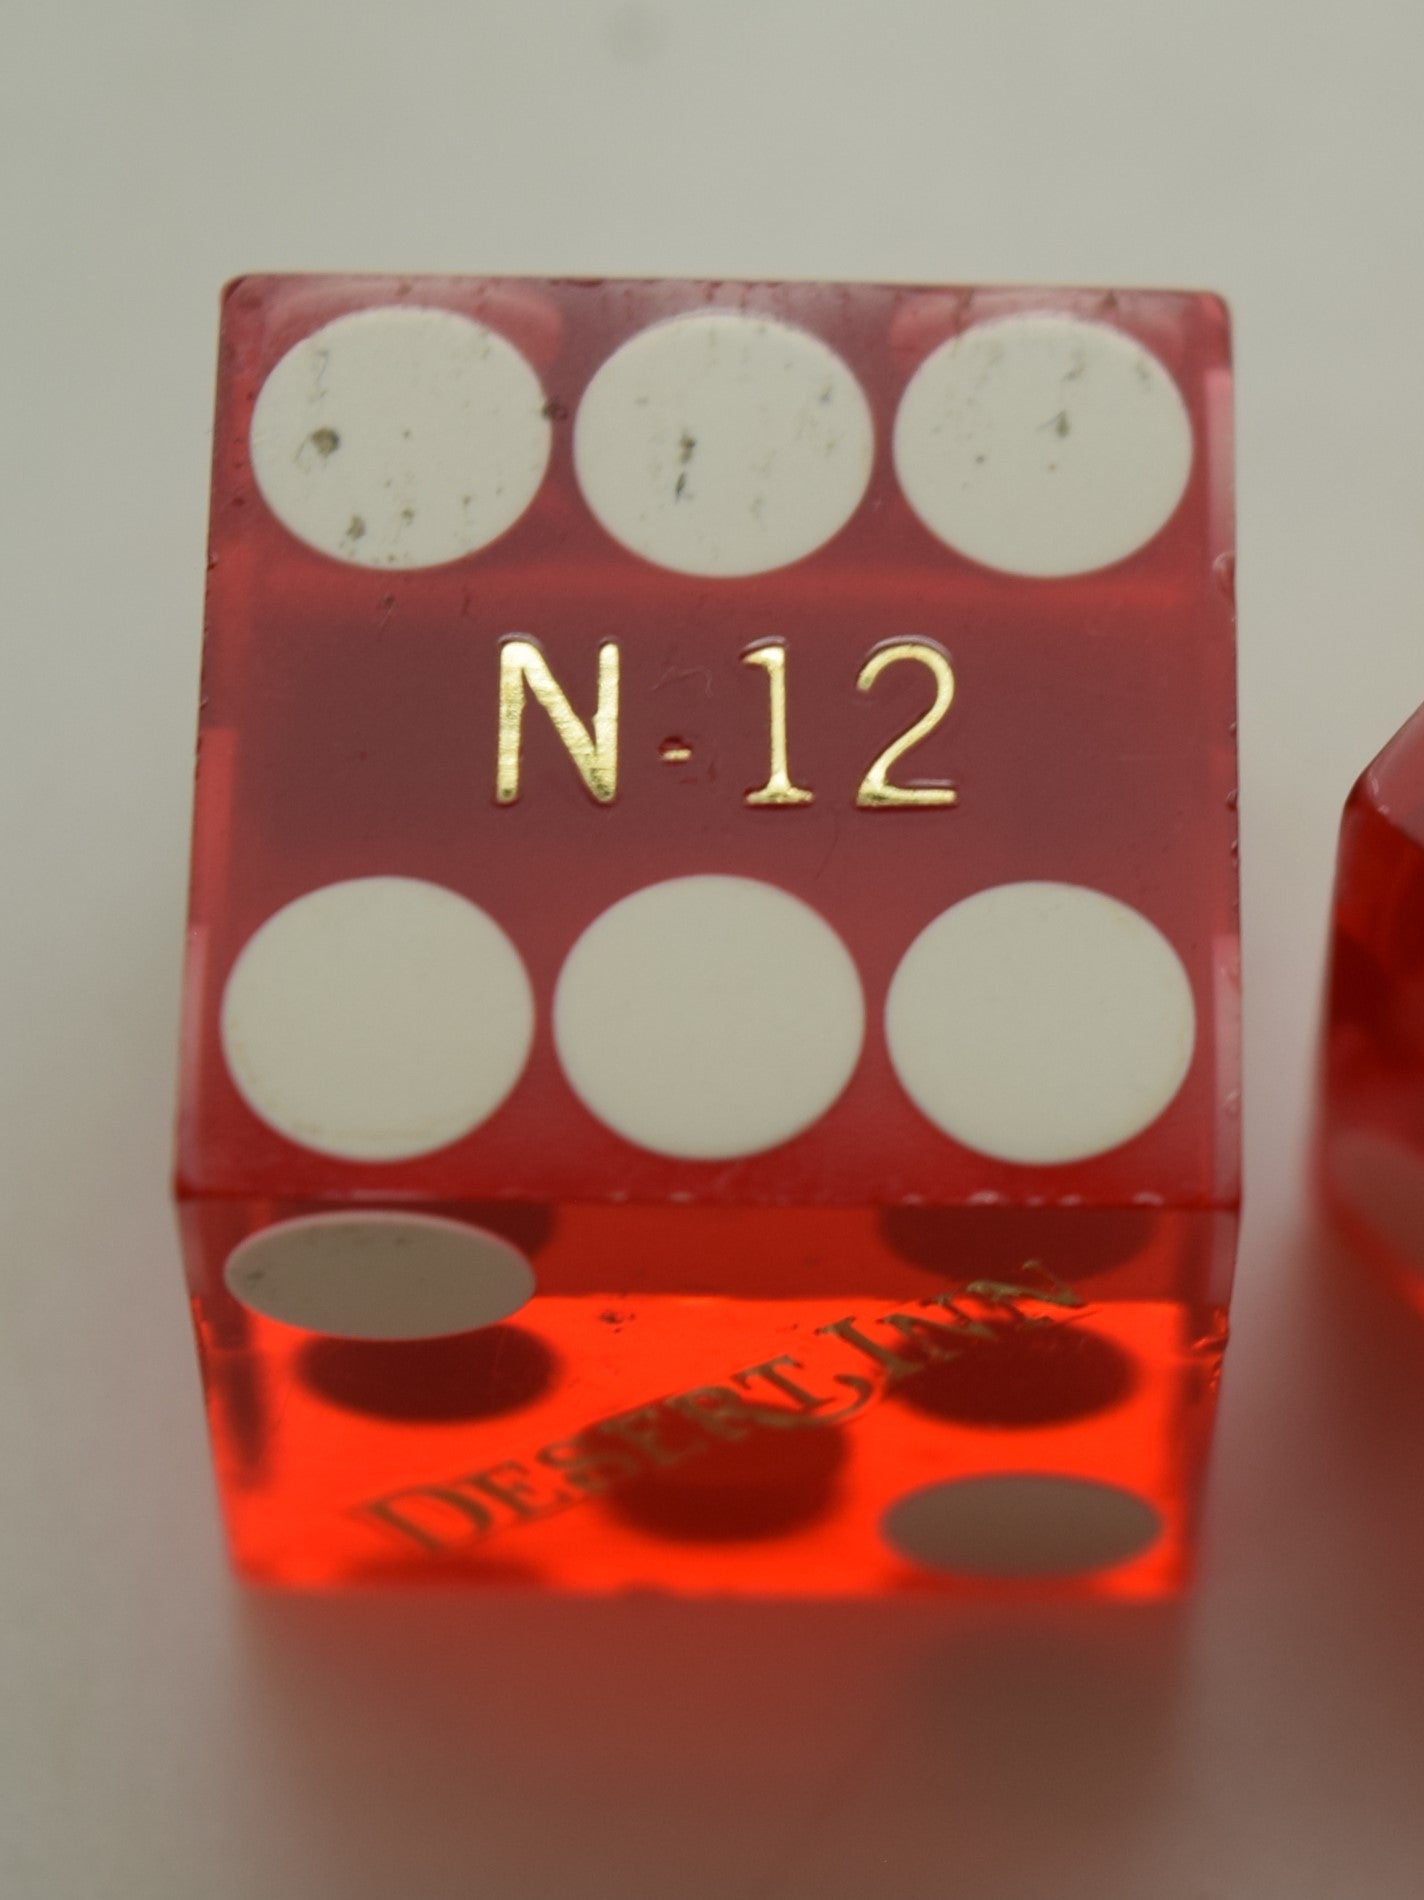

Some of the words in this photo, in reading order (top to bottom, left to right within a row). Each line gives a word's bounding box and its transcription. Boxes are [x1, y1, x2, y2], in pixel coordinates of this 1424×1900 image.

[496, 636, 958, 808] N-12
[352, 1353, 876, 1552] DESERT
[814, 1258, 1094, 1380] INN
